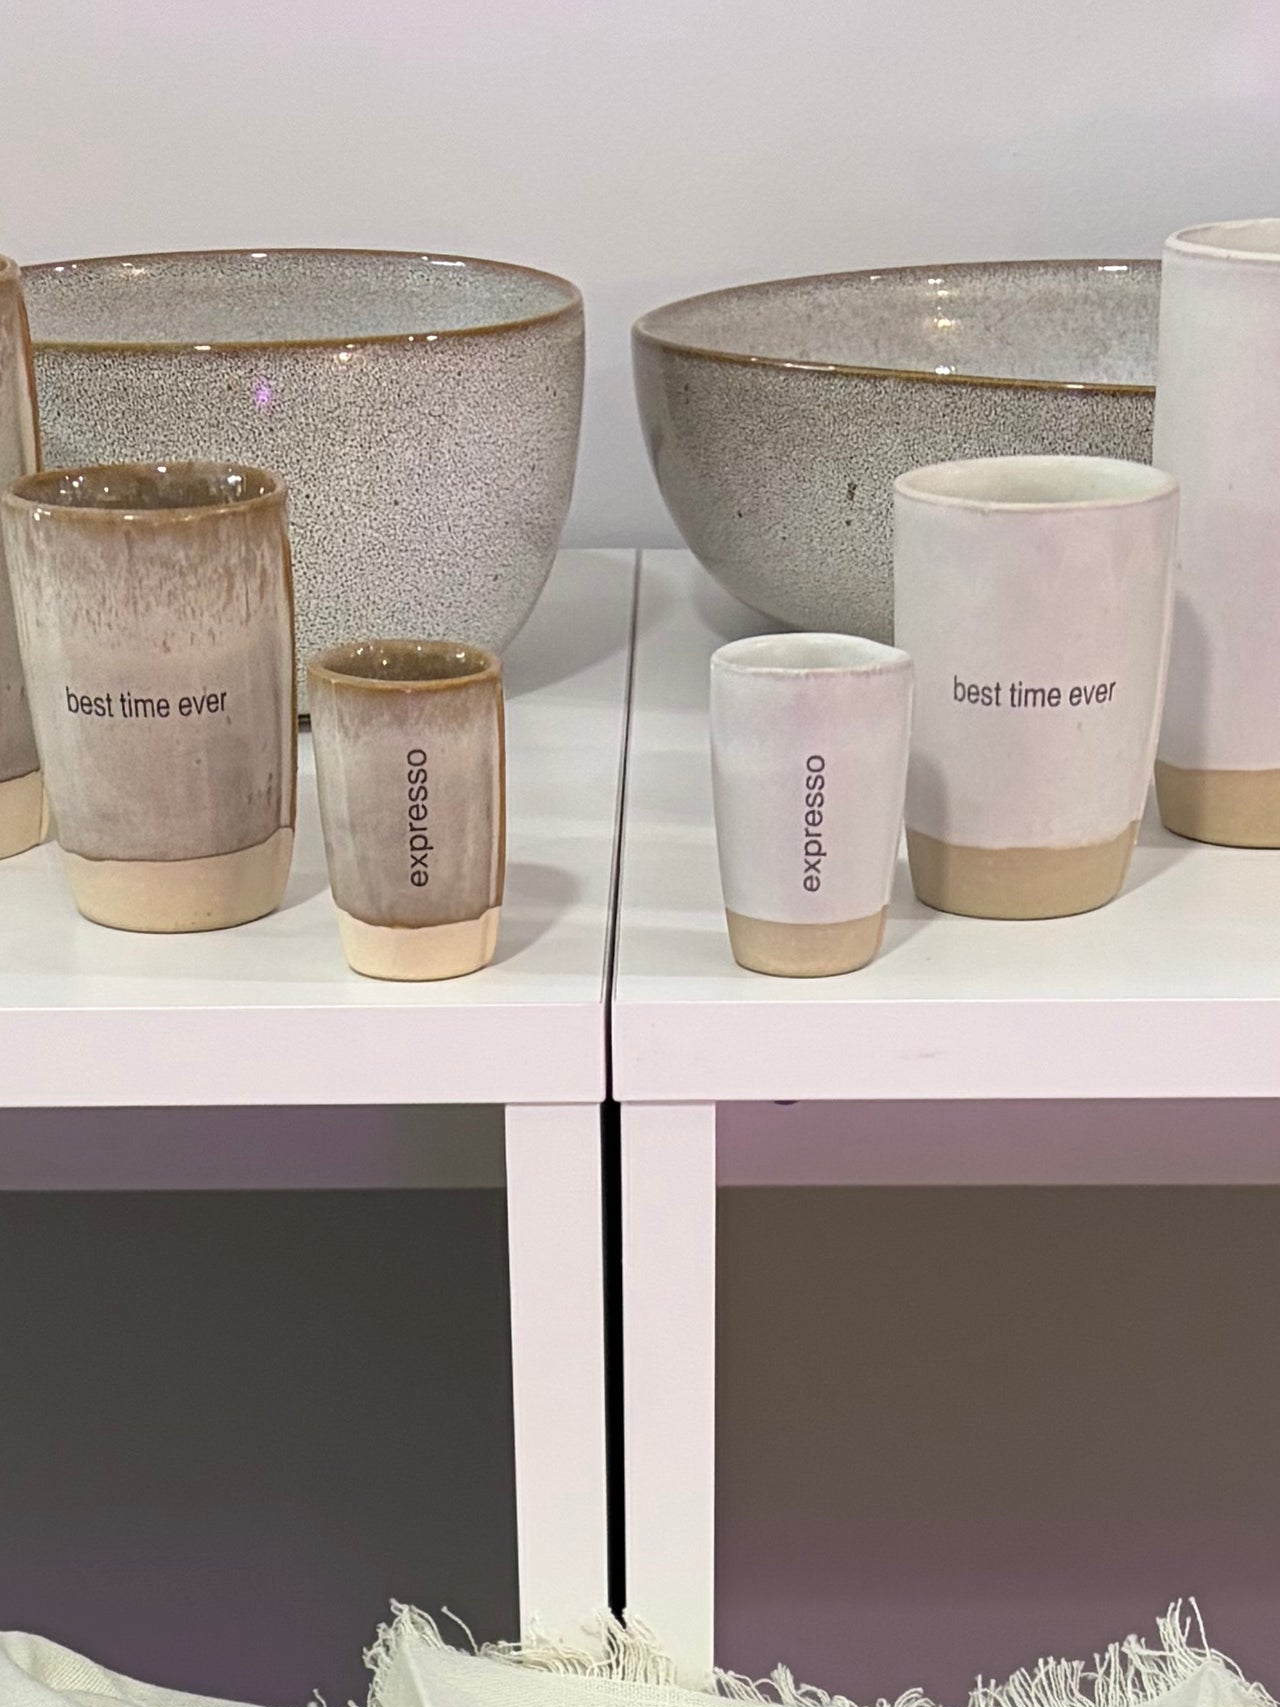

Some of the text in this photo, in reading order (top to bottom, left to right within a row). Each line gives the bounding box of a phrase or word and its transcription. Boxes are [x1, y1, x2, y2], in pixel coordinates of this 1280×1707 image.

[66, 686, 227, 718] best time ever
[953, 675, 1116, 708] best time ever
[407, 749, 434, 887] expresso
[803, 754, 827, 892] expresso
